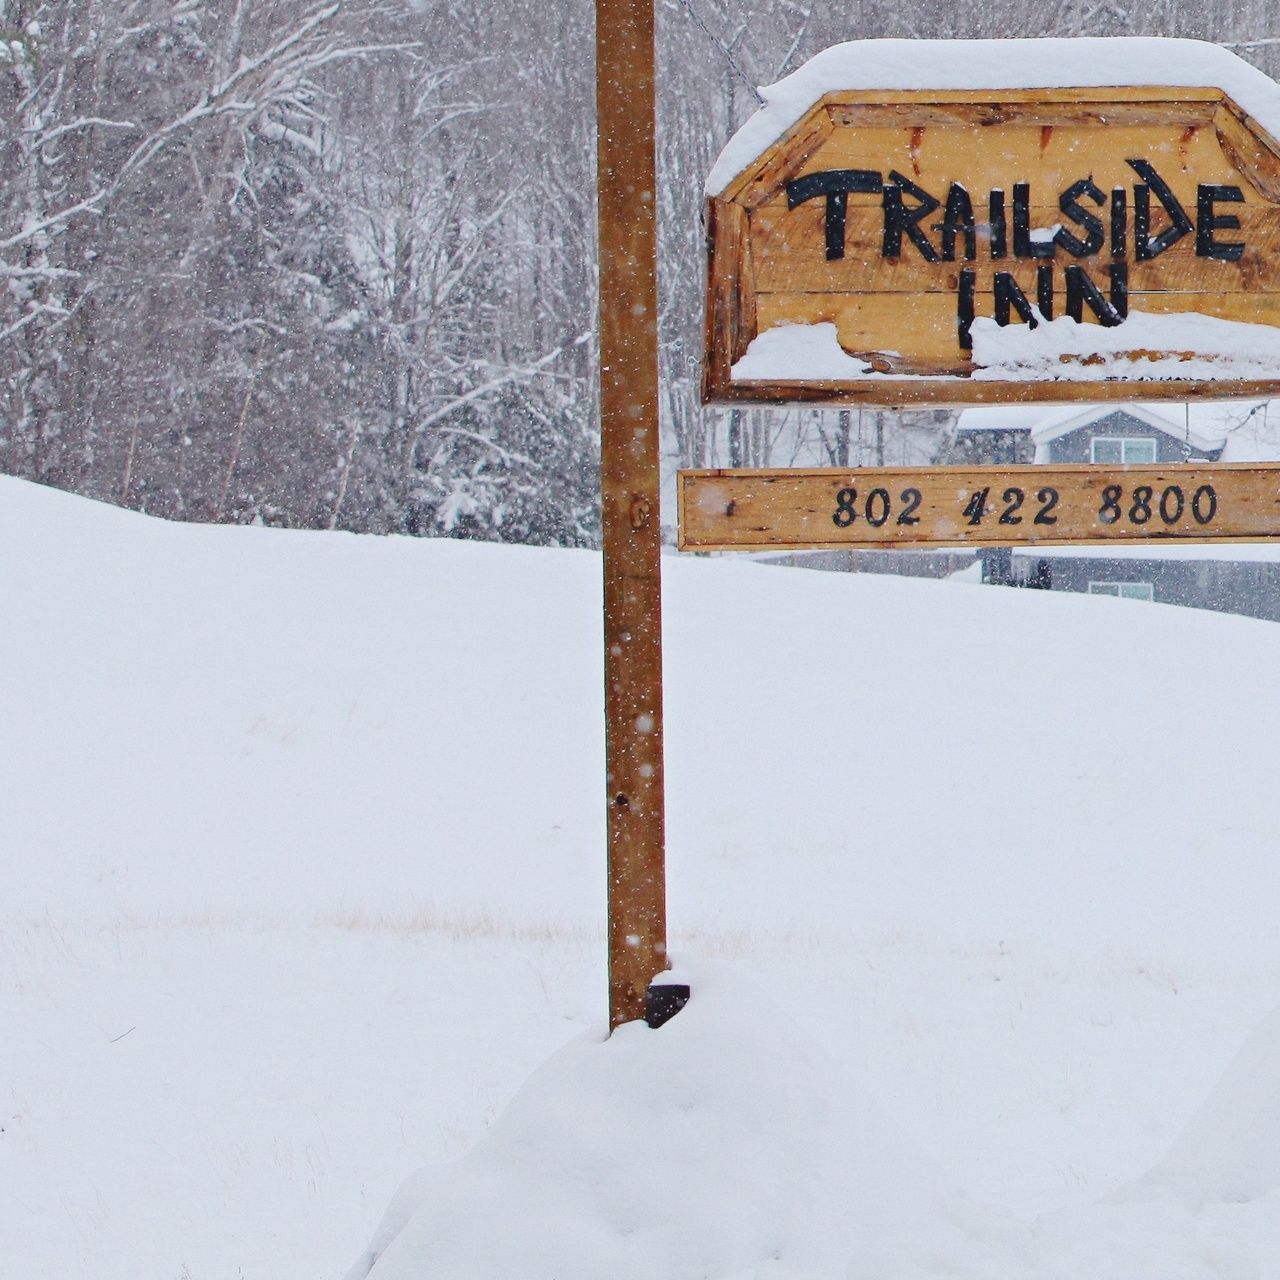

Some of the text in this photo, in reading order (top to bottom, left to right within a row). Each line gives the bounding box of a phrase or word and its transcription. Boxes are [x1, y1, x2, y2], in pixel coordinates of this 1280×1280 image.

[786, 158, 1246, 262] TRAILSIDE
[957, 263, 1128, 349] INN
[831, 483, 1218, 528] 802 422 8800
